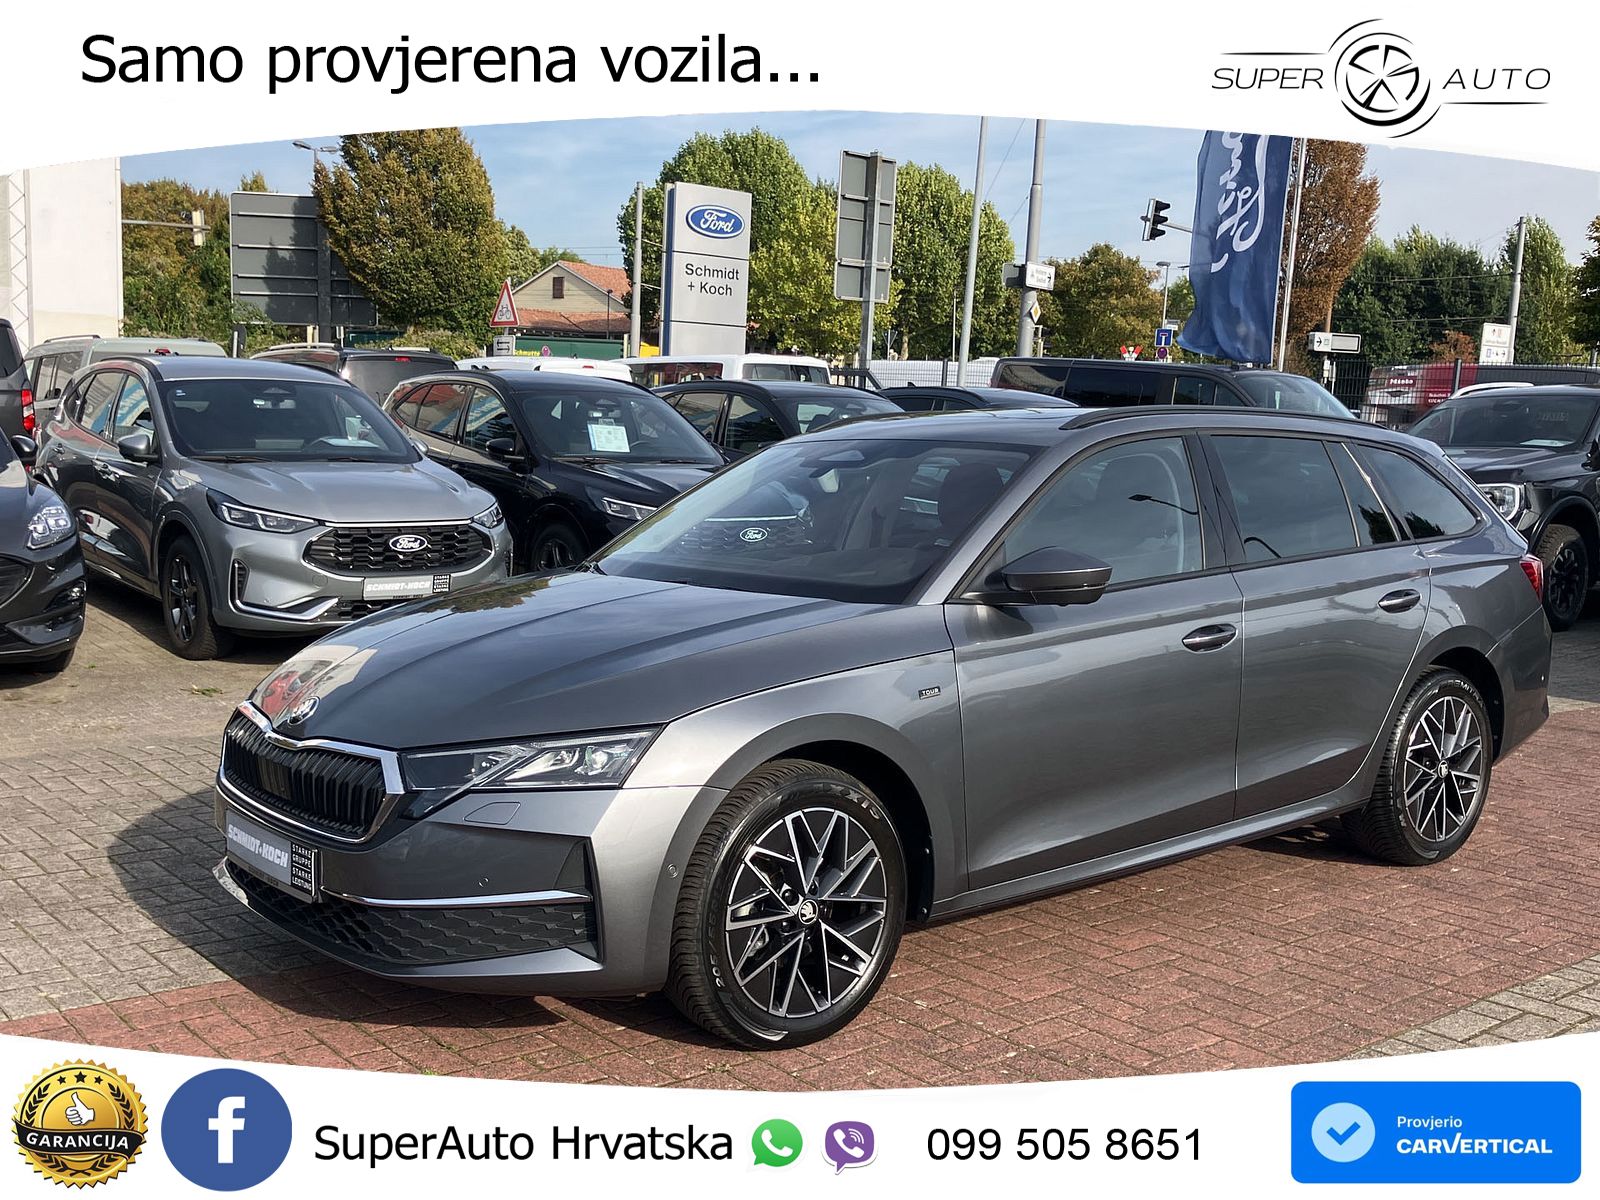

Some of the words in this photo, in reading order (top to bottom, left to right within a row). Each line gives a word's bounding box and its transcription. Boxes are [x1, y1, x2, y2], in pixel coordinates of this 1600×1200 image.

[700, 210, 735, 233] Ford
[685, 263, 740, 281] Schmidt
[687, 281, 695, 292] +
[699, 282, 733, 296] Koch
[744, 529, 763, 539] Ford
[396, 537, 421, 549] Ford
[921, 687, 939, 696] TOUR
[292, 844, 312, 858] STARKE
